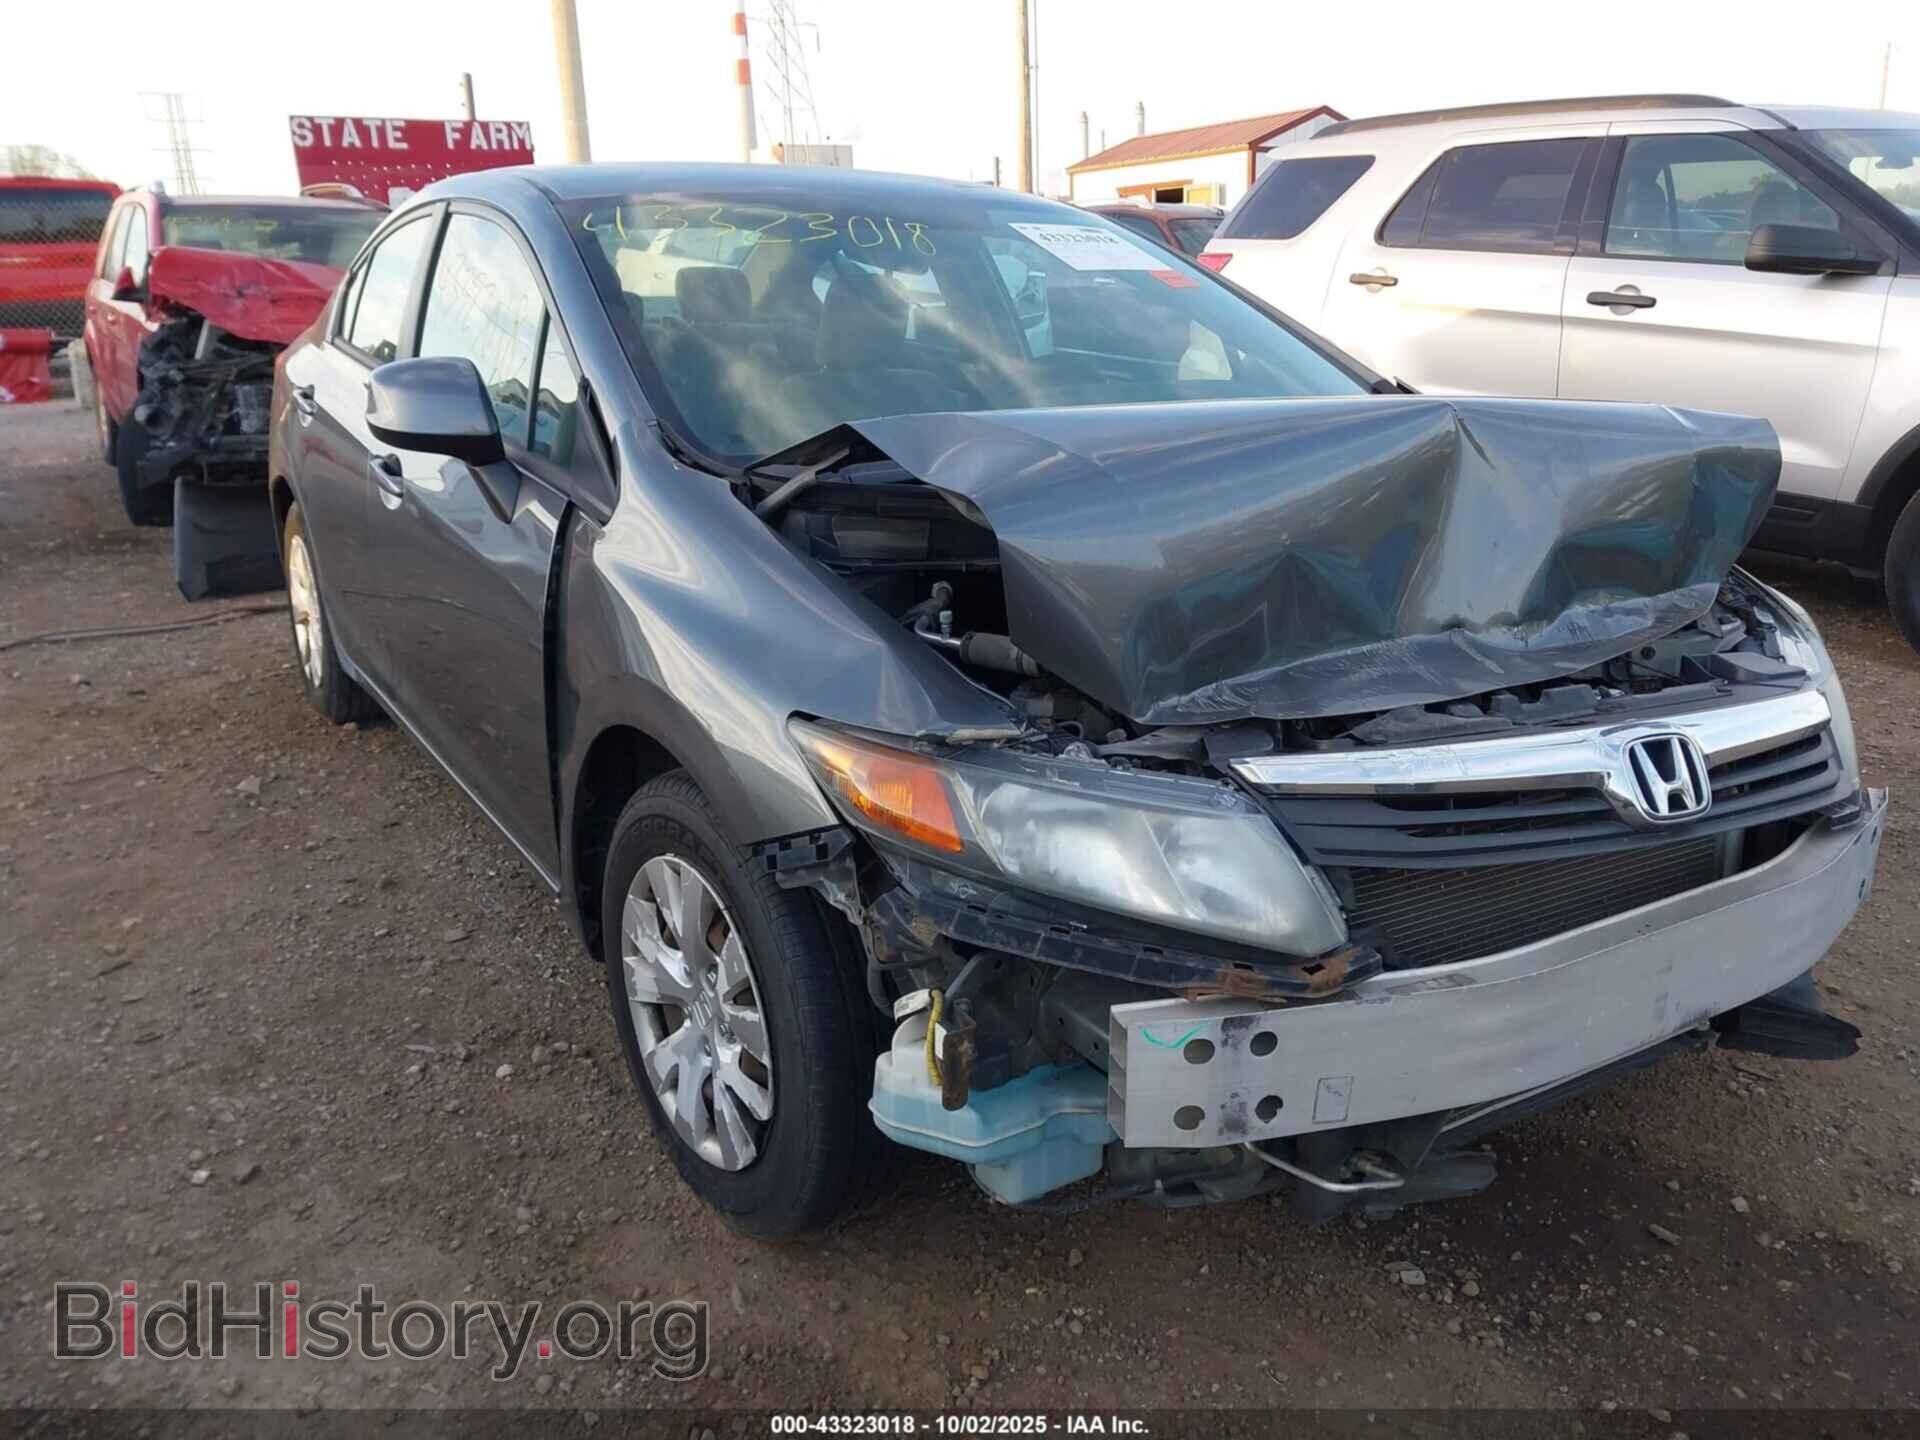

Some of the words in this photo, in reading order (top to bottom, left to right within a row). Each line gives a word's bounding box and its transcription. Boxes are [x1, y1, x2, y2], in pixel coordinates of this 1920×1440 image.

[290, 117, 409, 150] STATE
[444, 120, 535, 151] FARM
[583, 204, 937, 256] 43323018
